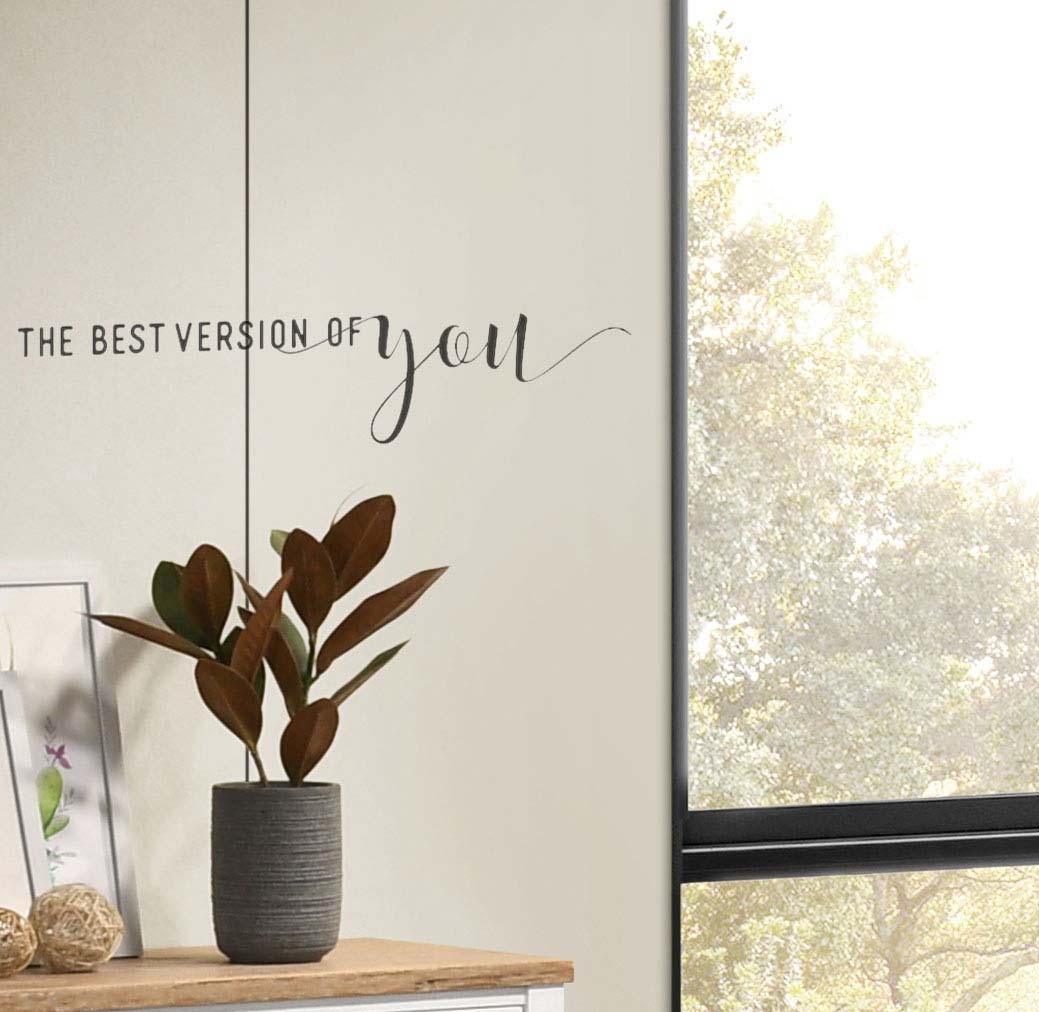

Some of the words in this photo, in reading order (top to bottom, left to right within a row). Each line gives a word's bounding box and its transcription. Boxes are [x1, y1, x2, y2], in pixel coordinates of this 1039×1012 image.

[17, 326, 74, 358] THE
[92, 323, 166, 355] BEST
[174, 318, 308, 351] VERSION
[327, 316, 362, 347] OF
[360, 313, 632, 444] you
